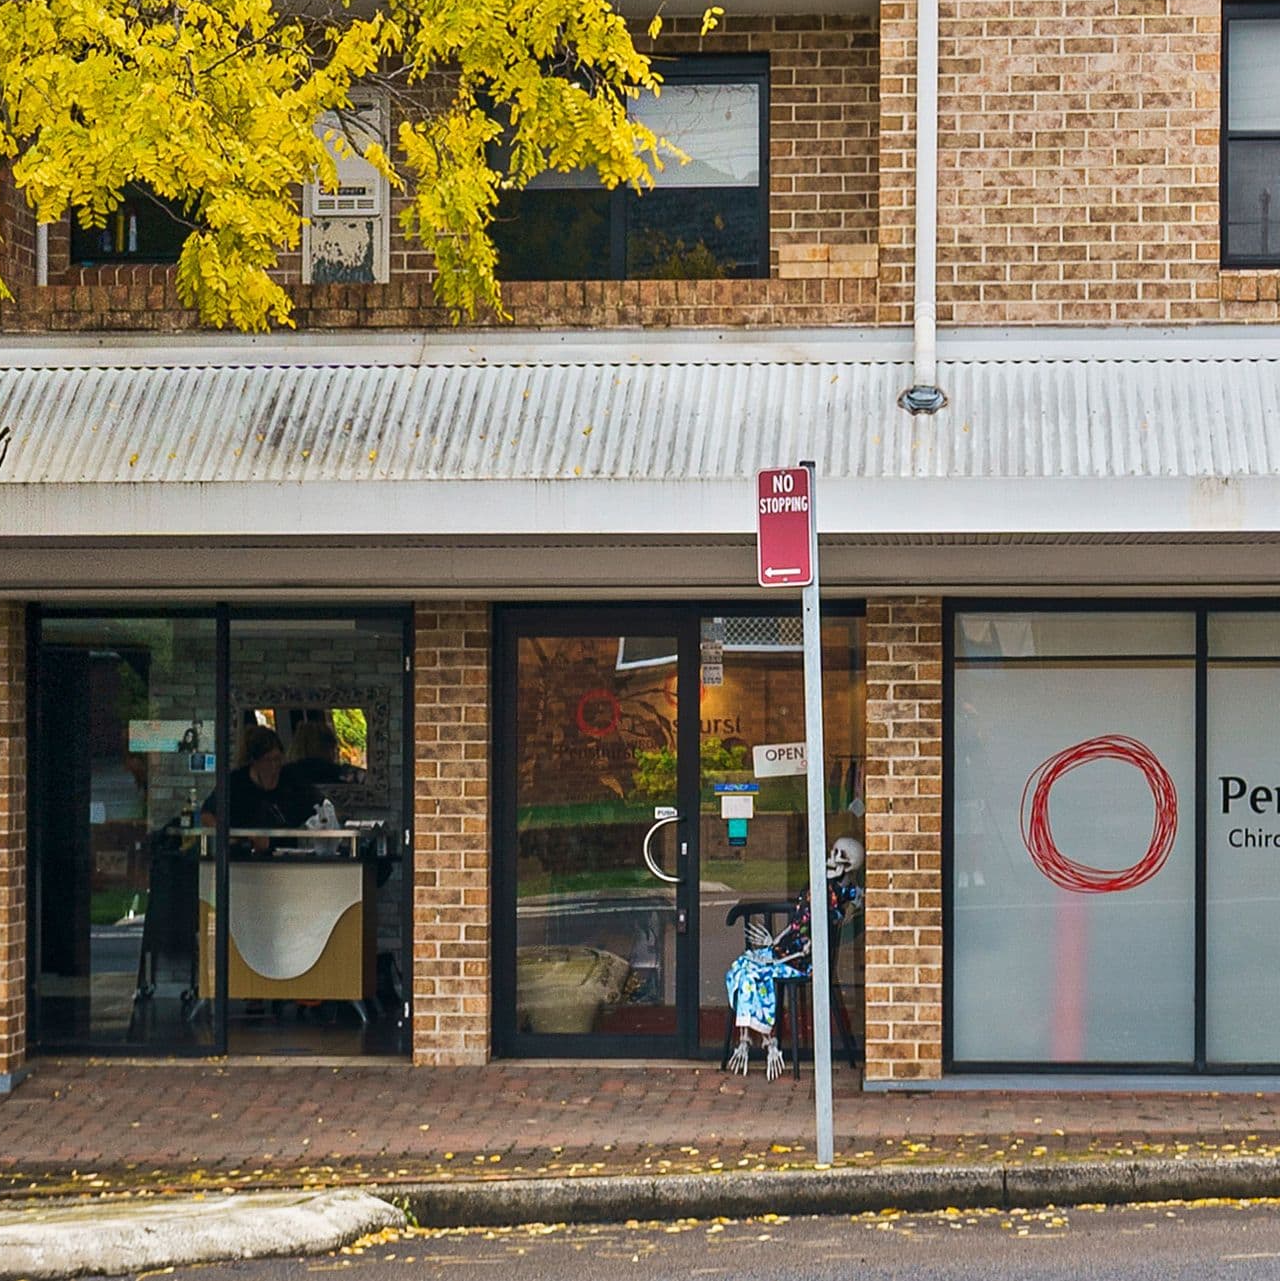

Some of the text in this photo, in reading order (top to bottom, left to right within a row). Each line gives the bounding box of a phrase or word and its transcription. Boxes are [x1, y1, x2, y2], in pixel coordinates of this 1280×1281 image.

[772, 474, 794, 493] NO
[760, 495, 808, 514] STOPPING
[765, 746, 804, 761] OPEN
